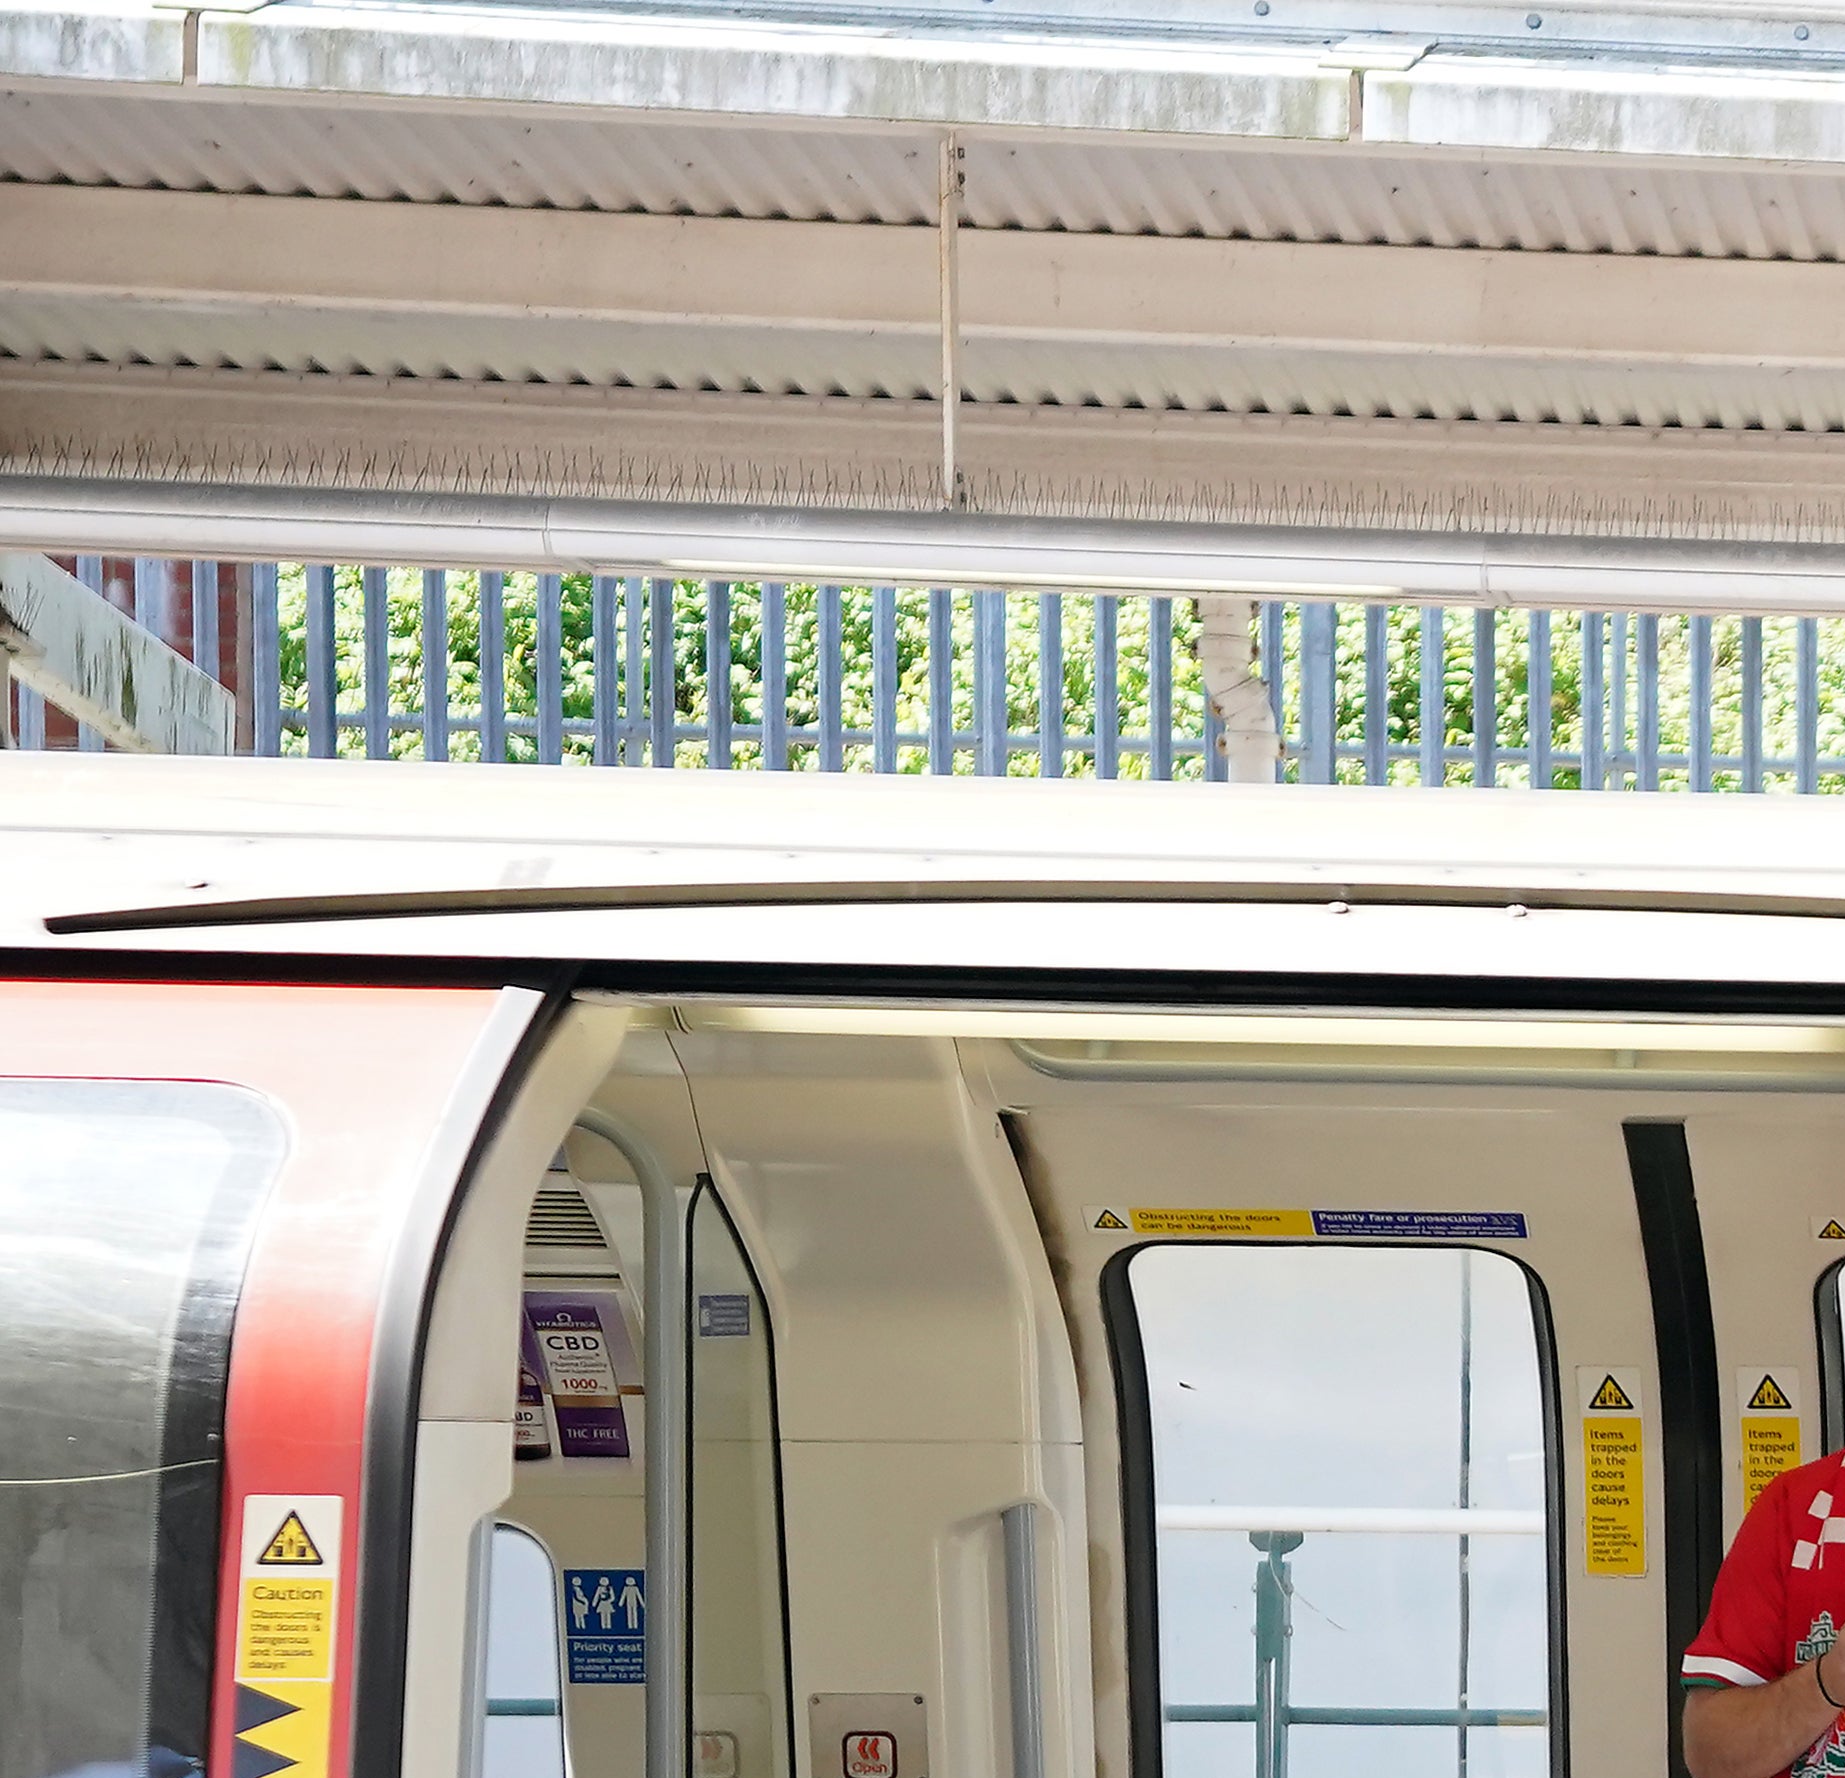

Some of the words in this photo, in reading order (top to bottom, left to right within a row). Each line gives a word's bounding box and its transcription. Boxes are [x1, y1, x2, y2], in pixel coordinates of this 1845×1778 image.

[1139, 1212, 1214, 1222] Obstructing
[1219, 1213, 1241, 1222] the
[1245, 1213, 1281, 1222] doors
[1319, 1212, 1365, 1223] Penalty
[1397, 1214, 1410, 1222] or
[1414, 1214, 1488, 1224] prosecution
[1141, 1222, 1163, 1230] can
[1167, 1222, 1184, 1230] be
[1188, 1222, 1252, 1232] dangerous
[547, 1336, 599, 1350] CBD
[562, 1378, 598, 1390] 1000
[566, 1428, 588, 1439] THC
[593, 1428, 620, 1440] FREE
[1748, 1429, 1782, 1439] Items
[1591, 1443, 1637, 1454] trapped
[1749, 1442, 1795, 1453] trapped
[1591, 1456, 1602, 1465] in
[1606, 1456, 1626, 1466] the
[1749, 1455, 1760, 1464] in
[1764, 1455, 1784, 1465] the
[1592, 1469, 1625, 1479] doors
[1750, 1468, 1782, 1478] door
[1592, 1484, 1625, 1492] cause
[1592, 1495, 1629, 1507] delays
[252, 1586, 323, 1600] Caution
[573, 1641, 614, 1654] Priority
[617, 1643, 642, 1652] seat
[852, 1761, 887, 1774] Open
